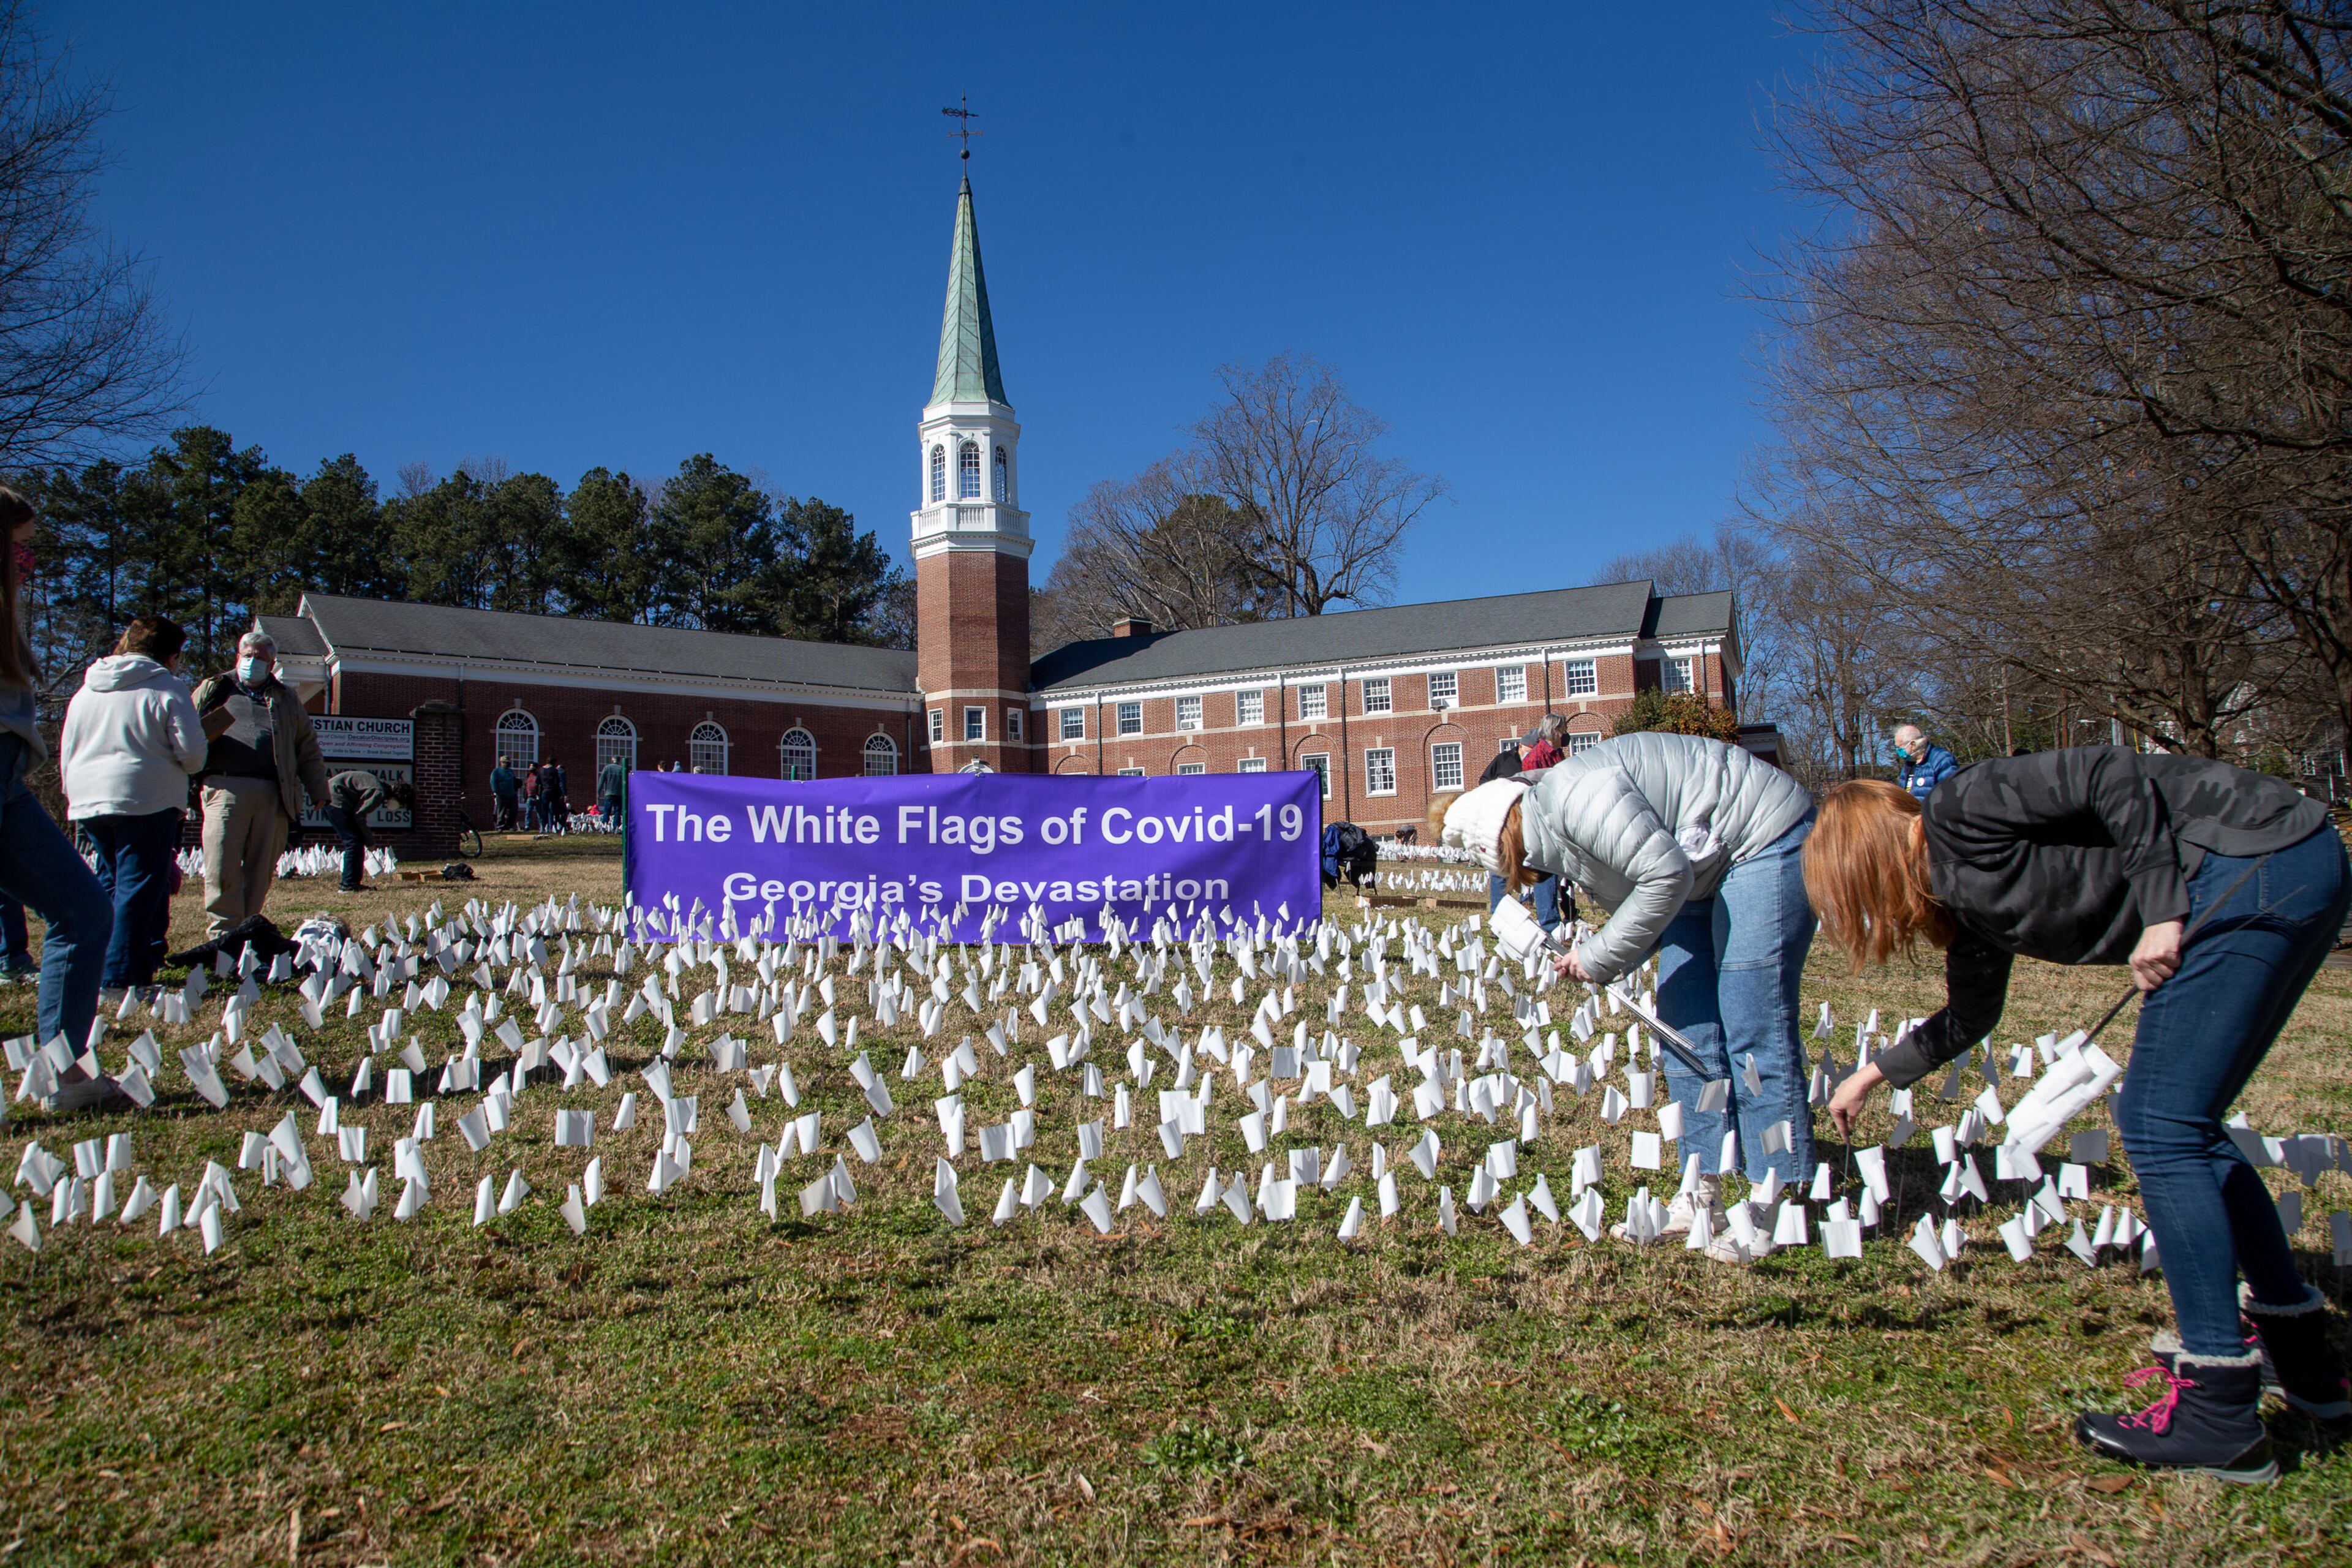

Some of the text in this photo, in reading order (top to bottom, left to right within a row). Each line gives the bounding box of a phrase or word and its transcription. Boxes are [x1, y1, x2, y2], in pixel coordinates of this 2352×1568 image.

[310, 719, 410, 733] STIAN CHURCH
[348, 734, 410, 743] DecaturDisciples.org
[377, 810, 410, 822] LOSS
[646, 804, 1303, 854] The White Flags of Covid-19
[723, 872, 1229, 910] Georgia’s Devastation
